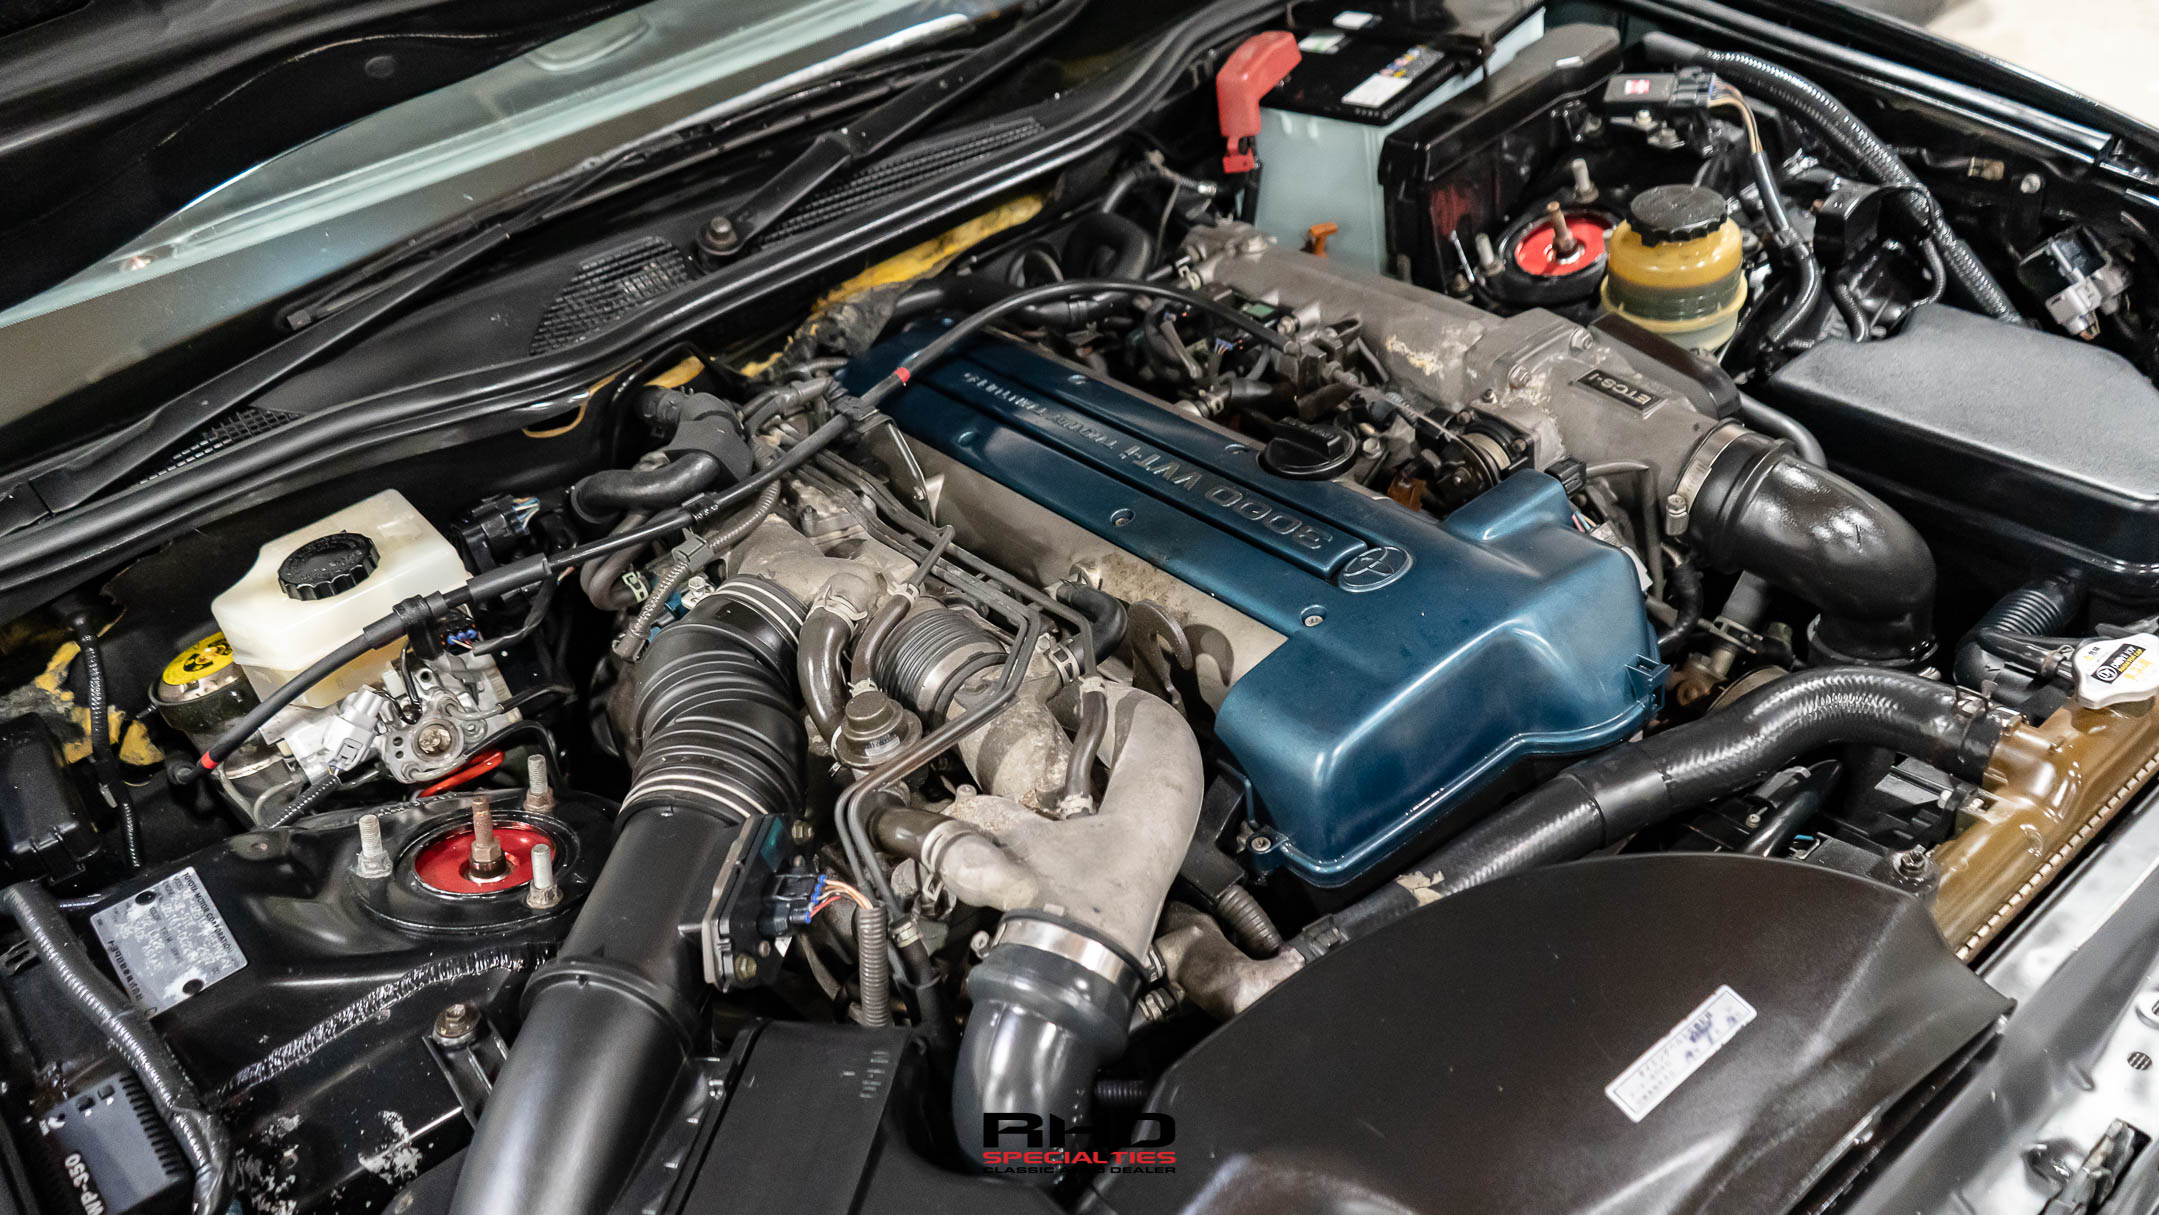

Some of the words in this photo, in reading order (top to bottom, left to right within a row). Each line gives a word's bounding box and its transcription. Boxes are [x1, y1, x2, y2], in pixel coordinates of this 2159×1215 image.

[1205, 486, 1333, 549] 3000
[182, 871, 198, 893] TOYOTA
[194, 891, 210, 913] MOTOR
[205, 911, 232, 954] CORPORATION
